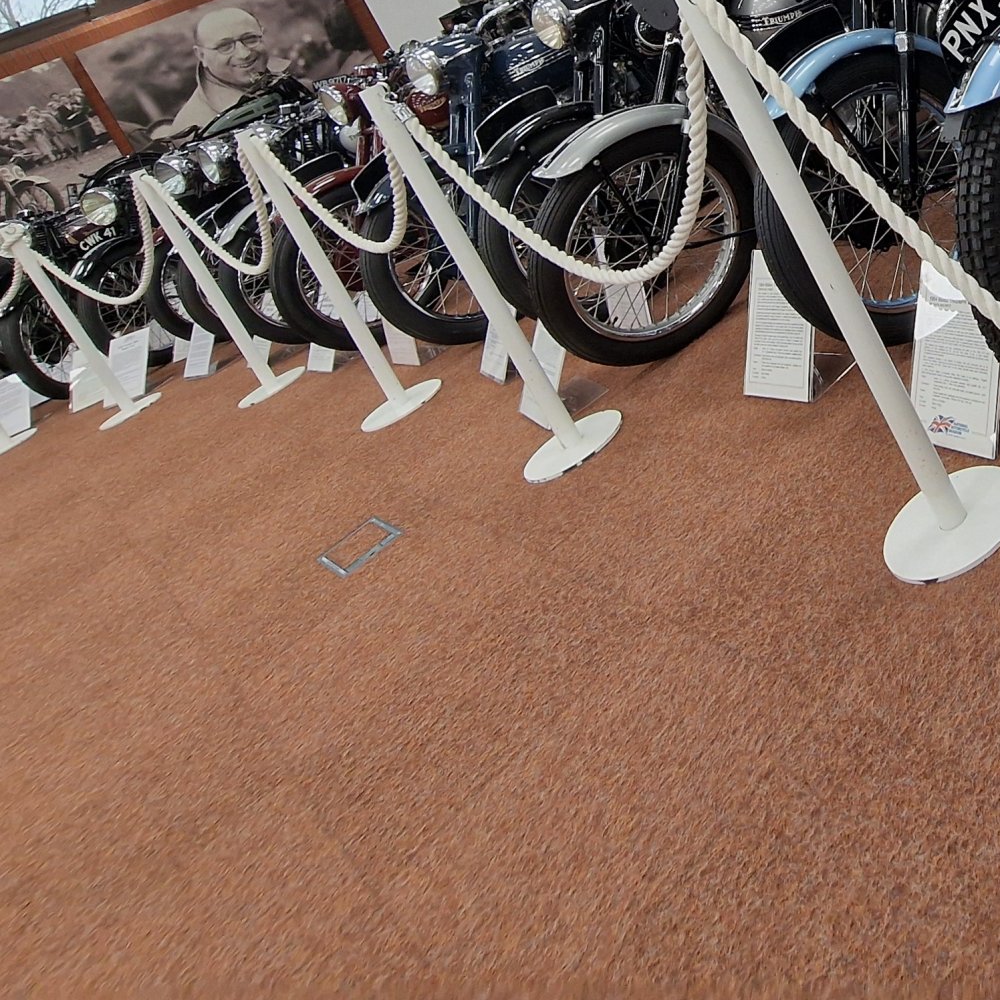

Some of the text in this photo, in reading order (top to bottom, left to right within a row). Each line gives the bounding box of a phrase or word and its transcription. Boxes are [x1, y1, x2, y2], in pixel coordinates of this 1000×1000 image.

[762, 10, 803, 26] TRIUMPH
[79, 226, 117, 251] CWK 41
